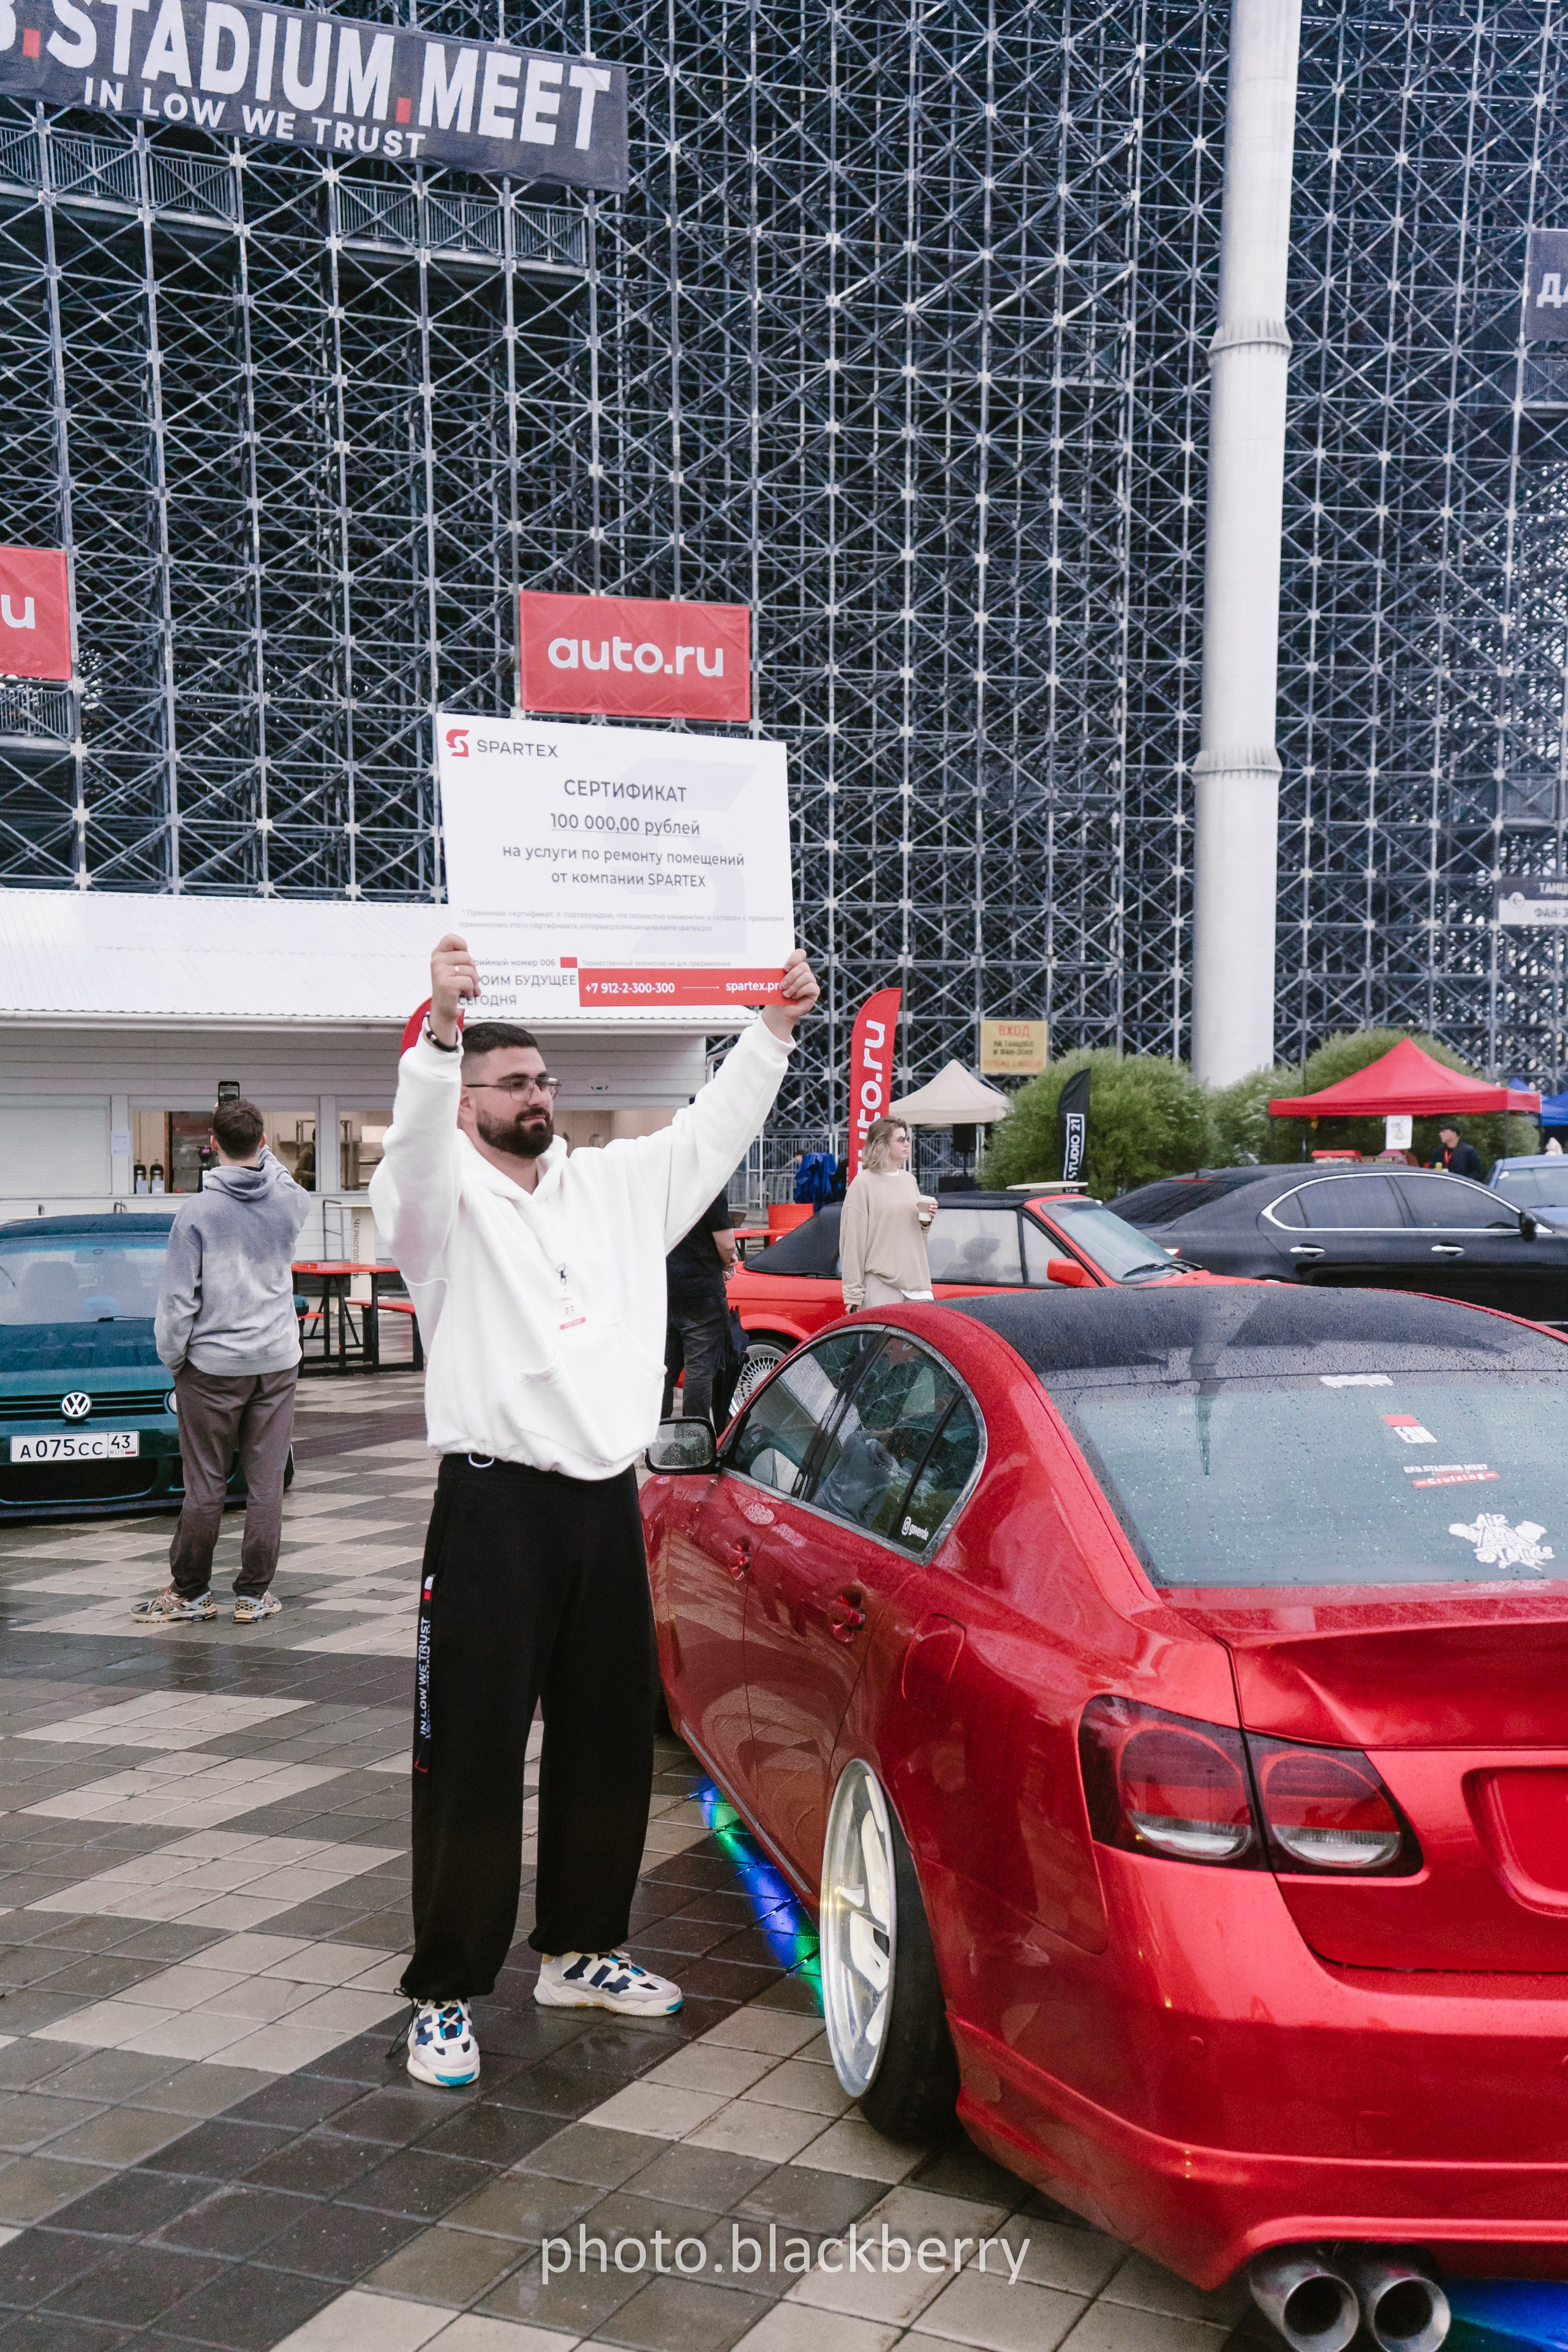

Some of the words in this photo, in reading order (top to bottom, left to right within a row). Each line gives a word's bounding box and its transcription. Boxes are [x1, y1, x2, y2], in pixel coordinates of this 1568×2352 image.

[84, 76, 124, 111] IN
[142, 87, 226, 127] LOW
[241, 105, 296, 140] WE
[311, 116, 426, 159] TRUST
[548, 636, 723, 677] auto.ru
[477, 739, 559, 758] SPARTEX
[564, 779, 686, 802] СЕРТИФИКАТ
[550, 813, 579, 829] 100
[584, 815, 639, 833] 000,00
[645, 818, 700, 836] рублей
[503, 846, 521, 857] на
[525, 846, 577, 861] услуги
[582, 849, 600, 860] по
[604, 850, 663, 865] ремонту
[667, 853, 744, 866] помещений
[551, 872, 568, 883] от
[572, 873, 644, 885] компании
[648, 873, 706, 887] SPARTEX
[480, 974, 511, 986] ОИМ
[515, 974, 576, 987] БУДУЩЕЕ
[585, 982, 598, 993] +7
[600, 982, 675, 993] 912-2-300-300
[725, 981, 782, 993] spartex.pr
[998, 1024, 1031, 1038] ВХОД
[1070, 1118, 1081, 1132] 21
[1068, 1134, 1081, 1180] STUDIO
[111, 1434, 130, 1449] 43
[418, 1616, 428, 1662] TRUST
[418, 1663, 427, 1685] WE
[418, 1687, 428, 1718] LOW
[420, 1720, 427, 1735] IN
